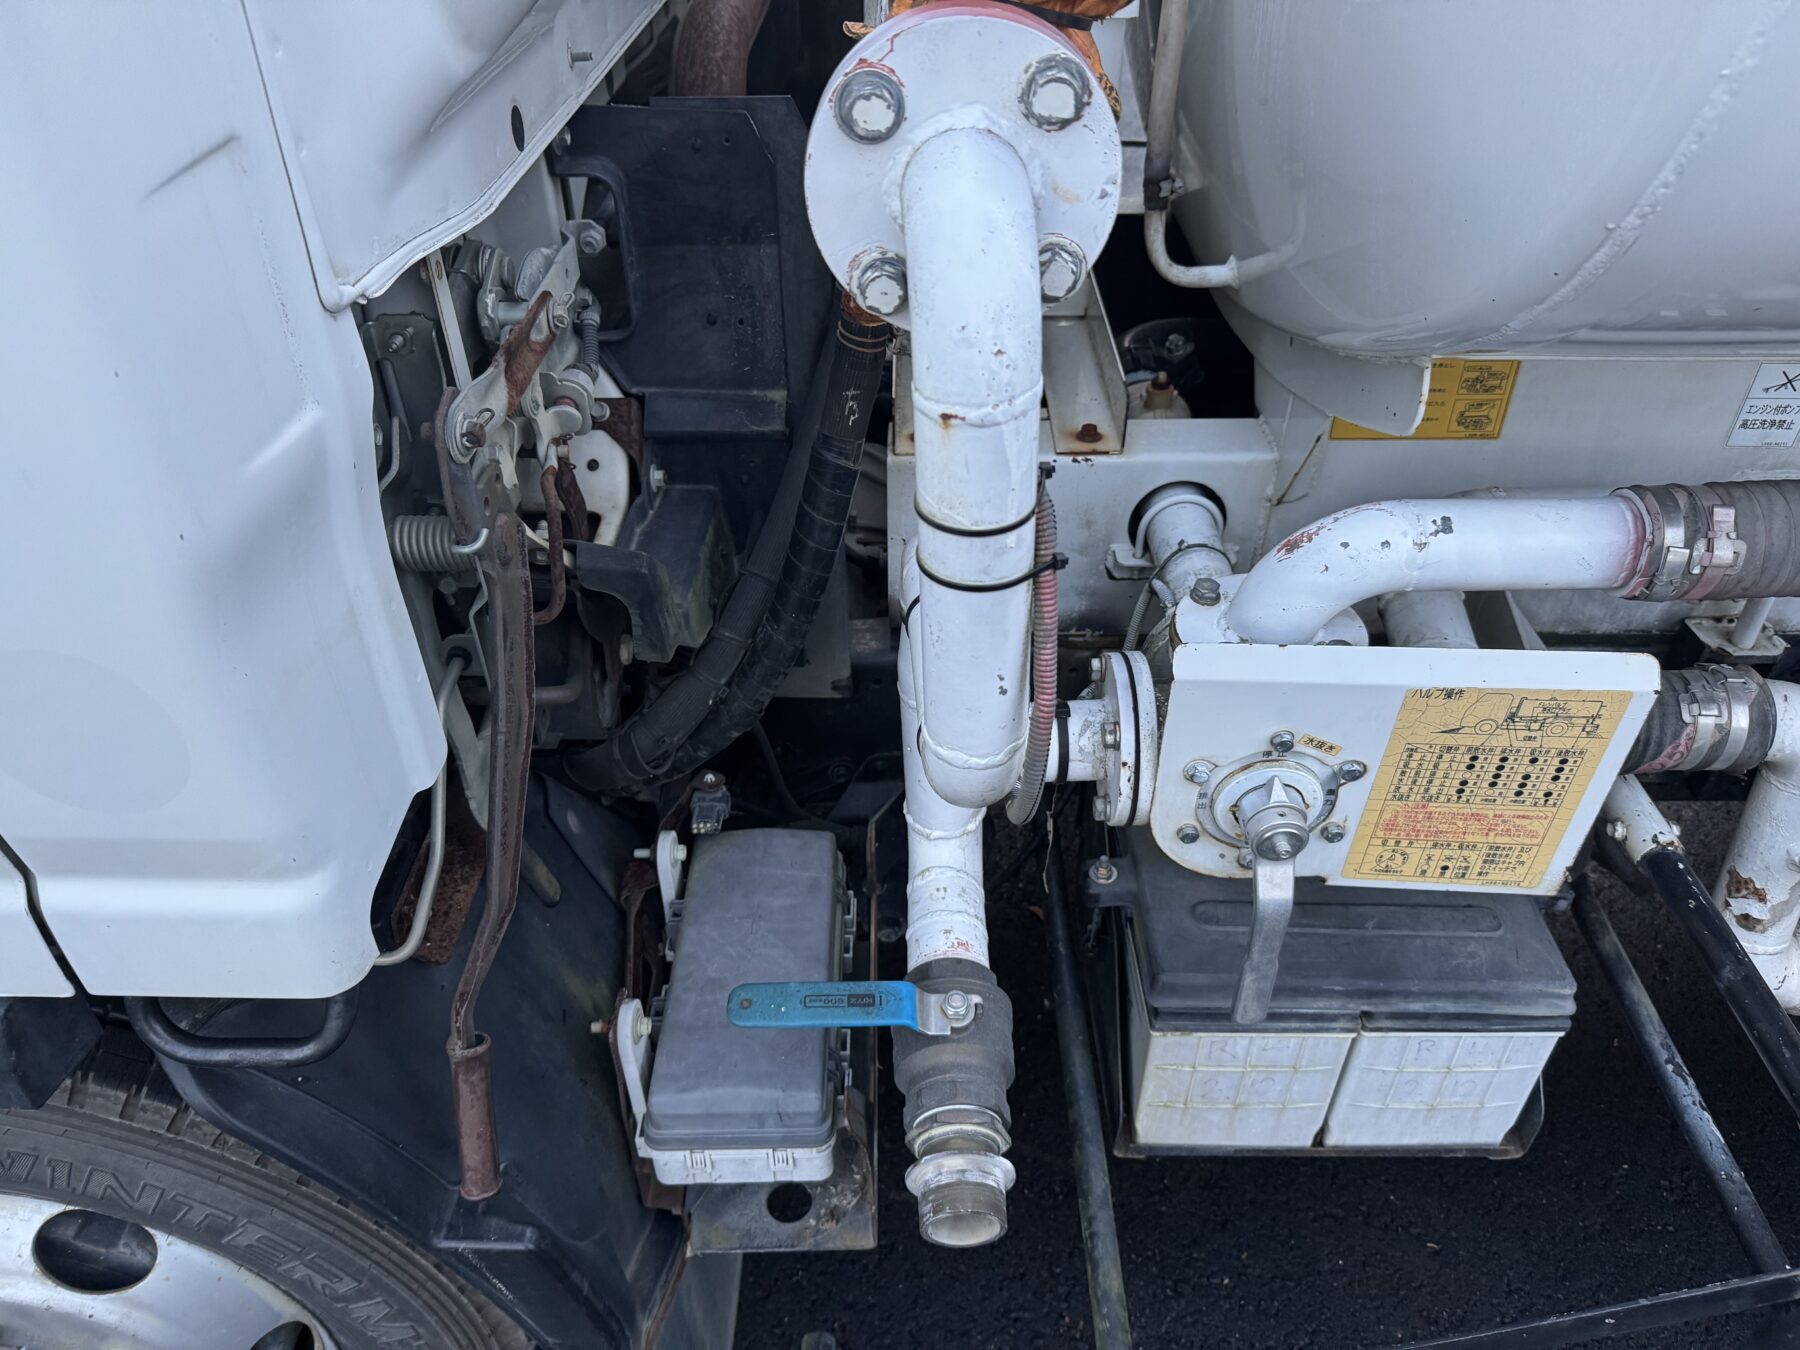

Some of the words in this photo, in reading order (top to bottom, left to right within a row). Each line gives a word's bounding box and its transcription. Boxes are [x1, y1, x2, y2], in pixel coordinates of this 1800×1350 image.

[1738, 419, 1795, 430] 高圧洗浄禁止
[1303, 737, 1336, 753] 水抜き
